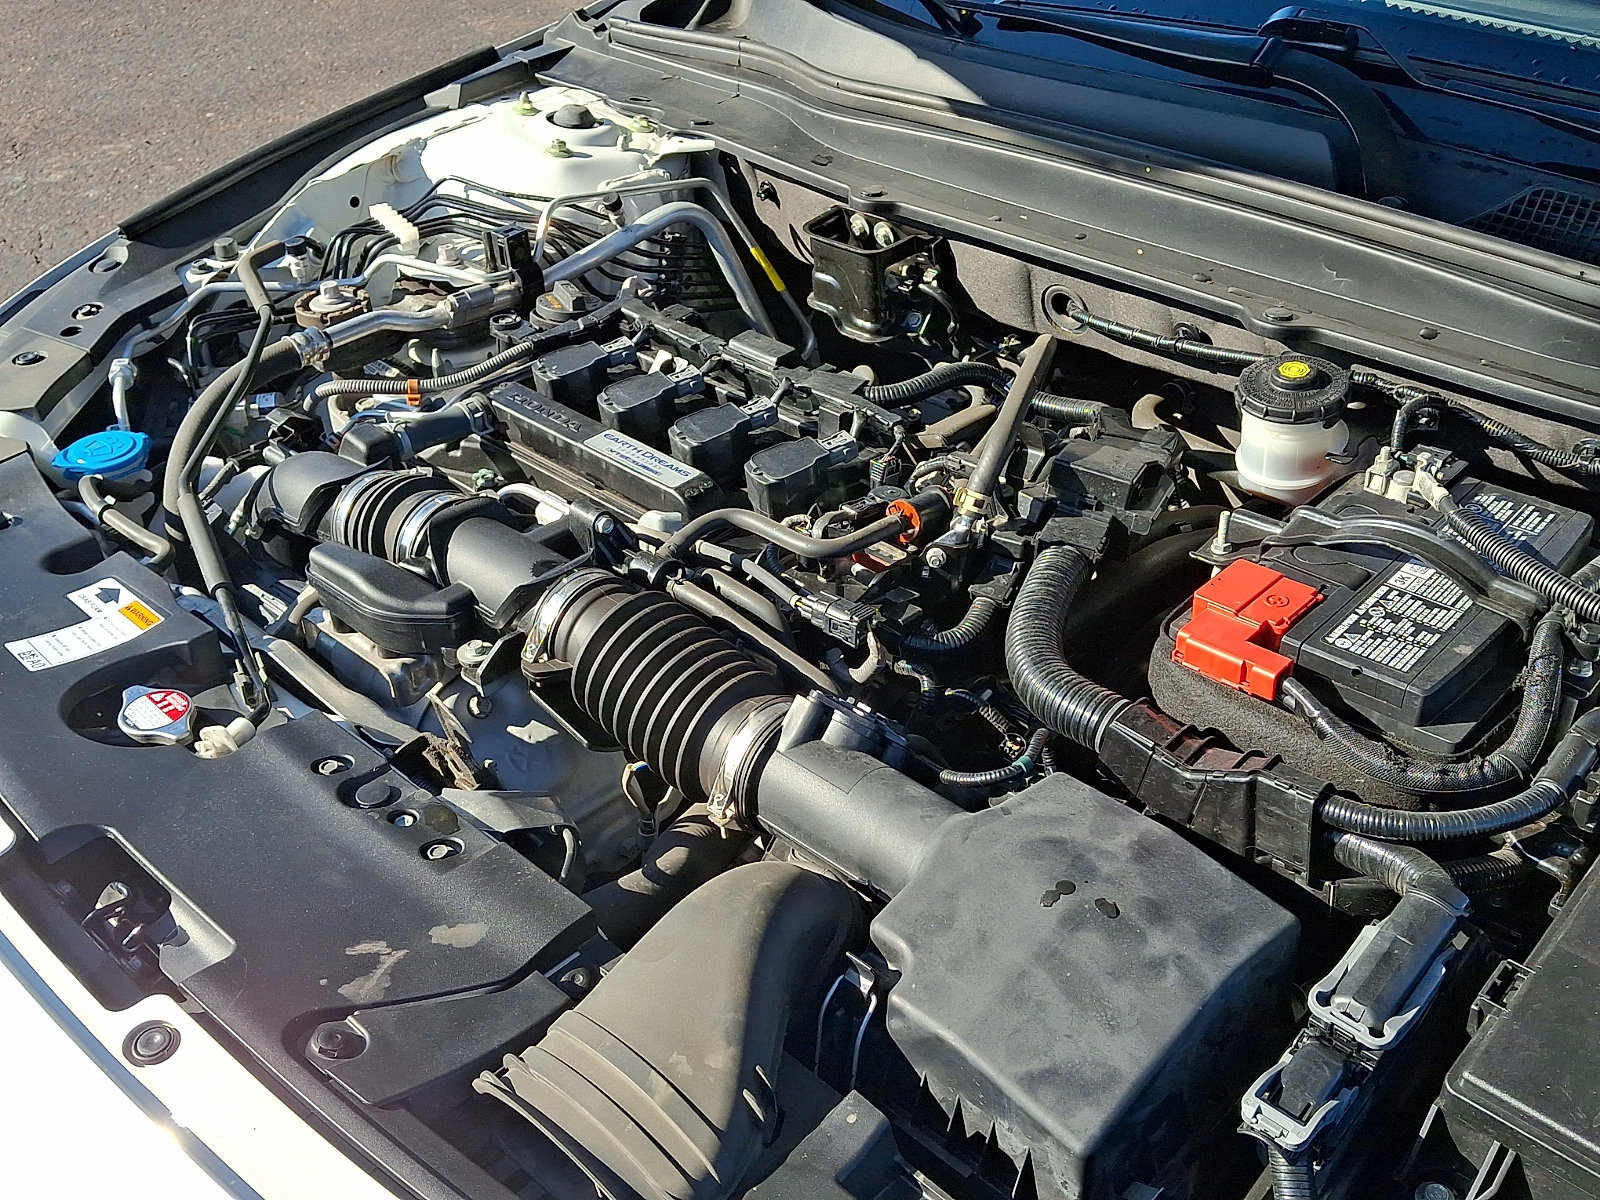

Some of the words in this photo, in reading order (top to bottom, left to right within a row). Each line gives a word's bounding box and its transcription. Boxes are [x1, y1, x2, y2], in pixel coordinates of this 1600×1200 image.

[506, 391, 582, 433] HONDA
[603, 433, 643, 454] EARTH
[640, 450, 692, 477] DREAMS
[130, 607, 155, 627] WARNING
